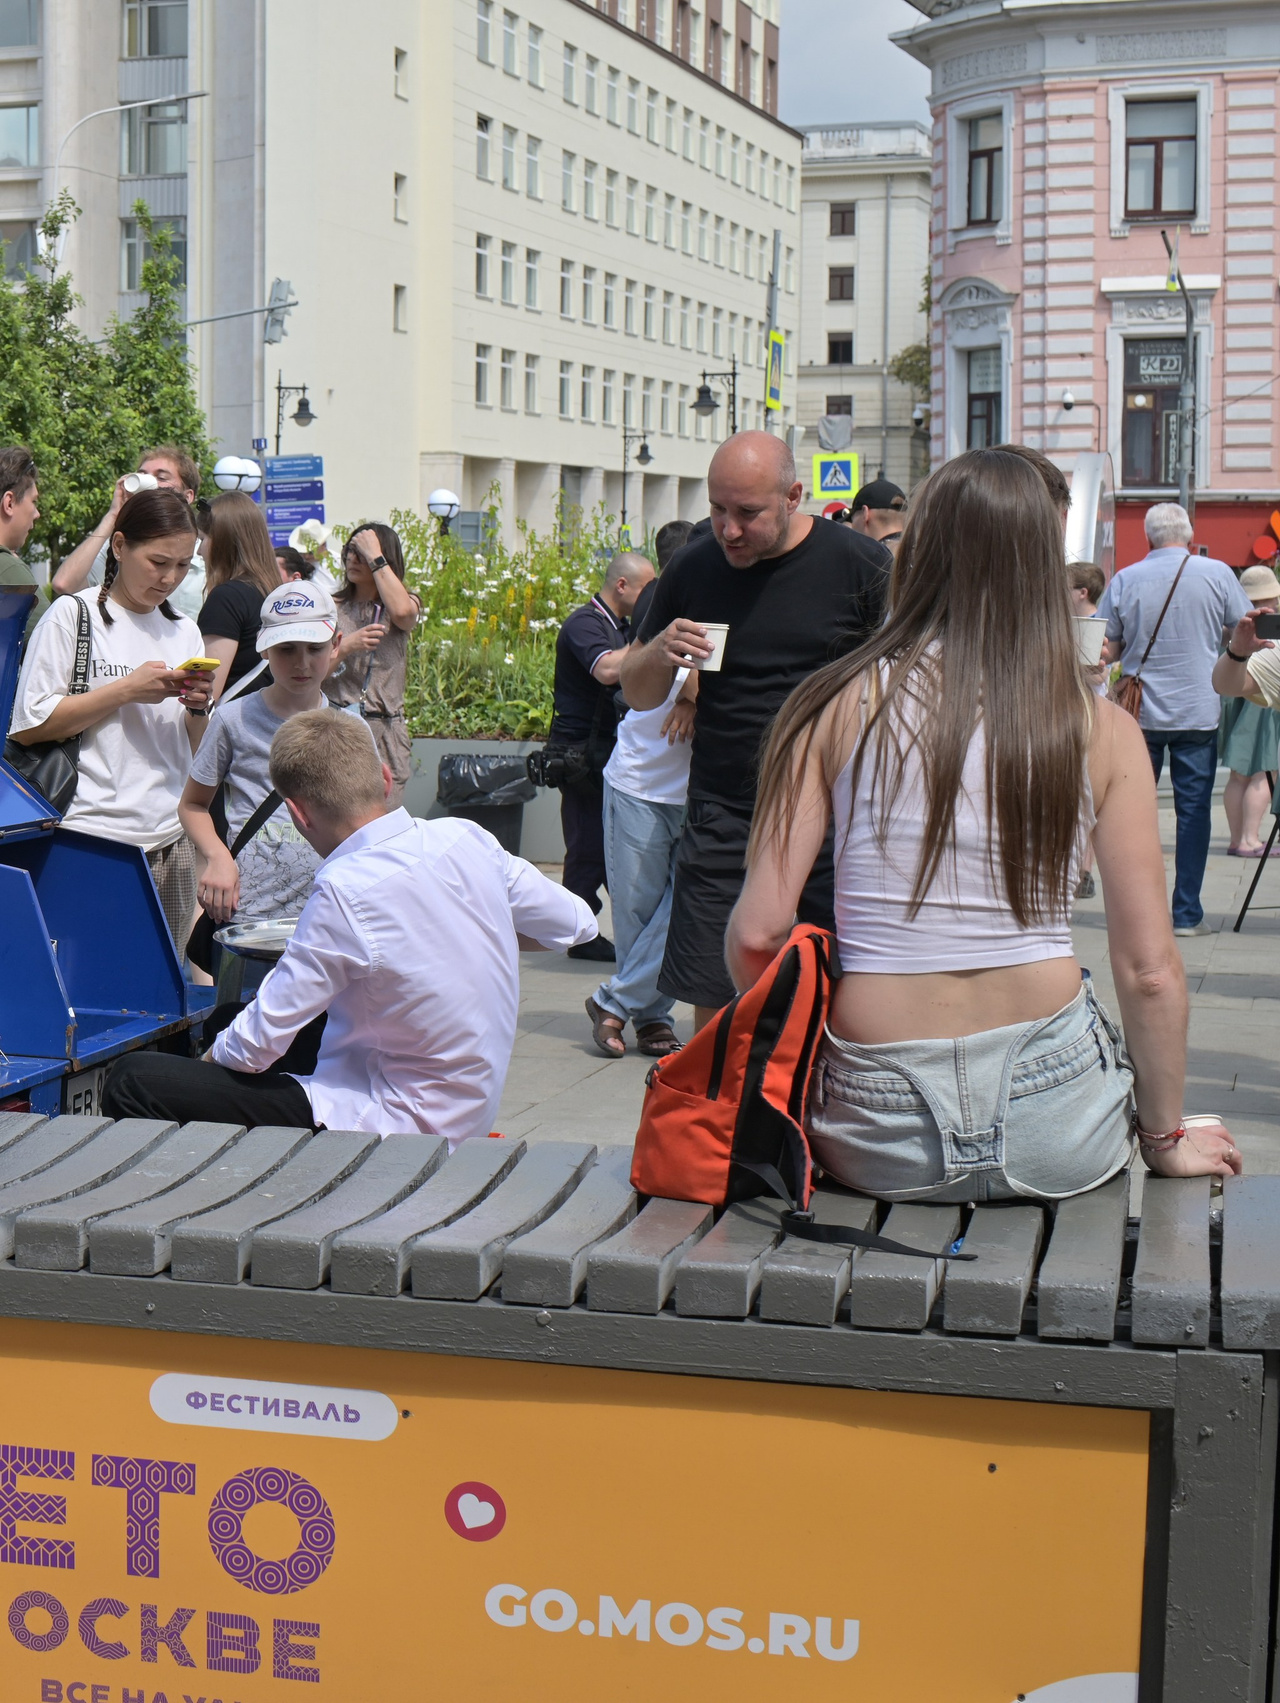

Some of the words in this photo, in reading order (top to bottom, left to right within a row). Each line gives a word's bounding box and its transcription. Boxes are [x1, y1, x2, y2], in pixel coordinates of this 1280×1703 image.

[76, 641, 89, 673] GUESS
[185, 1391, 361, 1424] ФЕСТИВАЛЬ
[485, 1583, 860, 1661] GO.MOS.RU
[41, 1679, 110, 1703] ВСЕ
